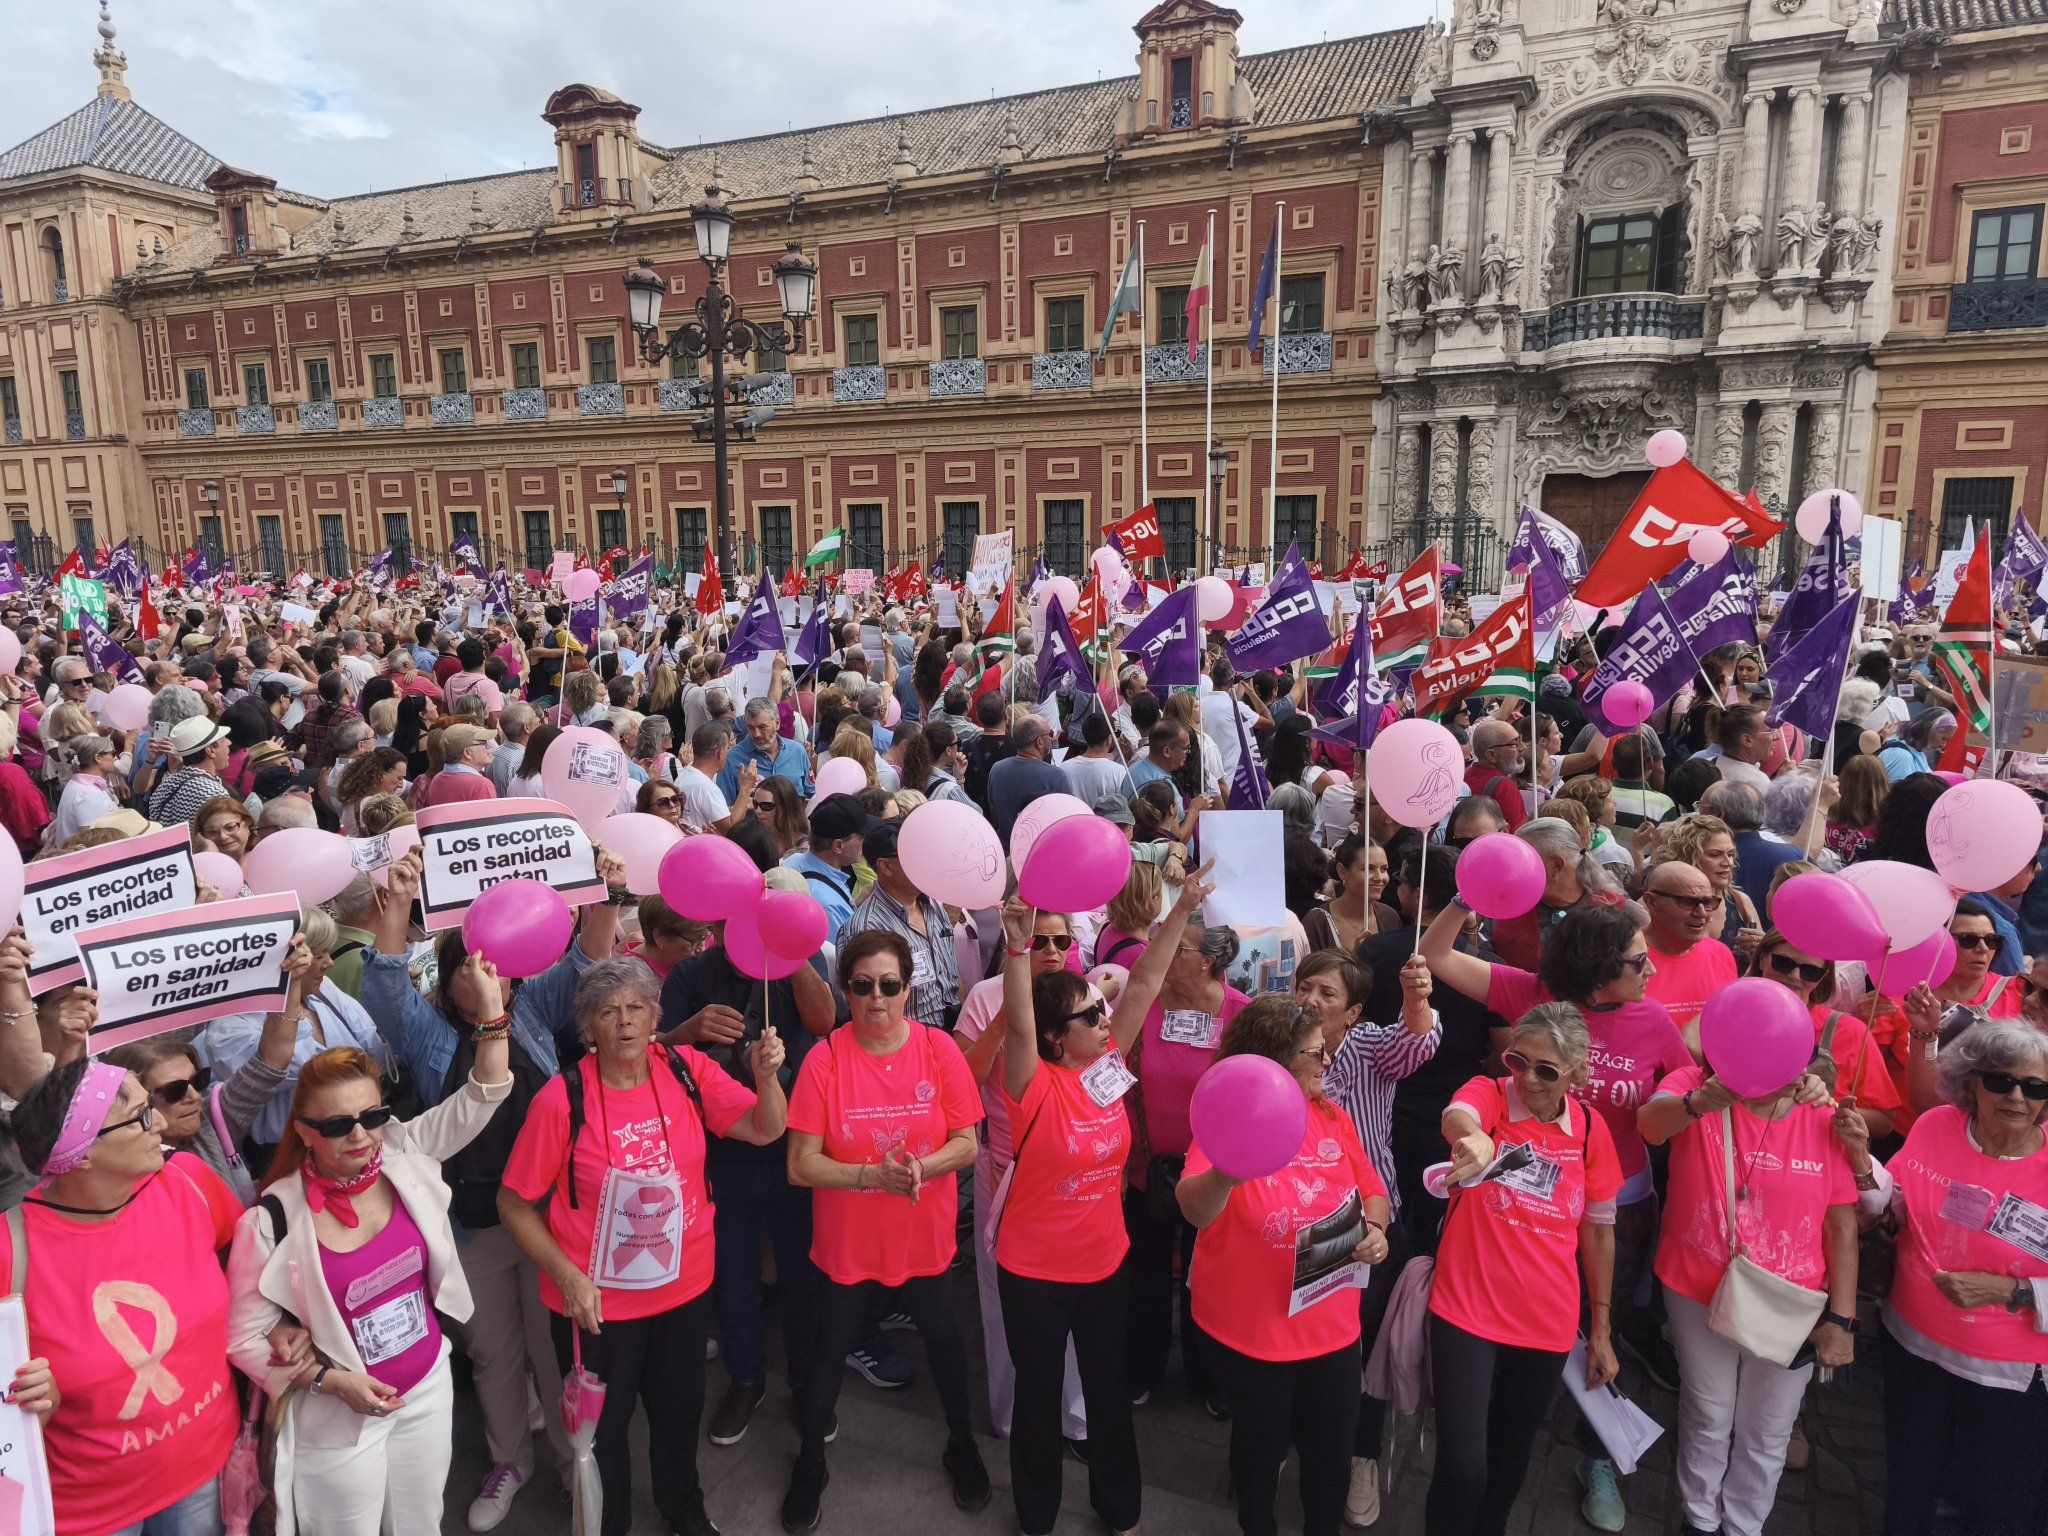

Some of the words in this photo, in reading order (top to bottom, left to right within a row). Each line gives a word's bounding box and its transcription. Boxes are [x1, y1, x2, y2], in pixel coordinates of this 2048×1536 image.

[436, 838, 481, 856] Los
[487, 822, 575, 850] recortes
[449, 857, 477, 875] en
[484, 840, 571, 870] sanidad
[36, 891, 82, 916] Los
[88, 863, 179, 901] recortes
[50, 917, 79, 934] en
[86, 882, 173, 925] sanidad
[110, 948, 166, 970] Los
[174, 932, 278, 961] recortes
[126, 974, 159, 992] en
[167, 952, 266, 984] sanidad
[151, 979, 229, 1007] matan
[1791, 1159, 1824, 1172] DKV
[1907, 1159, 1951, 1187] OYSHO
[613, 1208, 637, 1219] Todas
[638, 1213, 654, 1221] con
[616, 1231, 648, 1240] Nuestras
[650, 1230, 667, 1240] vidas
[618, 1241, 646, 1249] pueden
[646, 1238, 671, 1249] esperar
[1298, 1275, 1331, 1298] MORENO
[1331, 1263, 1364, 1280] BONILLA
[120, 1381, 223, 1456] AMAMA
